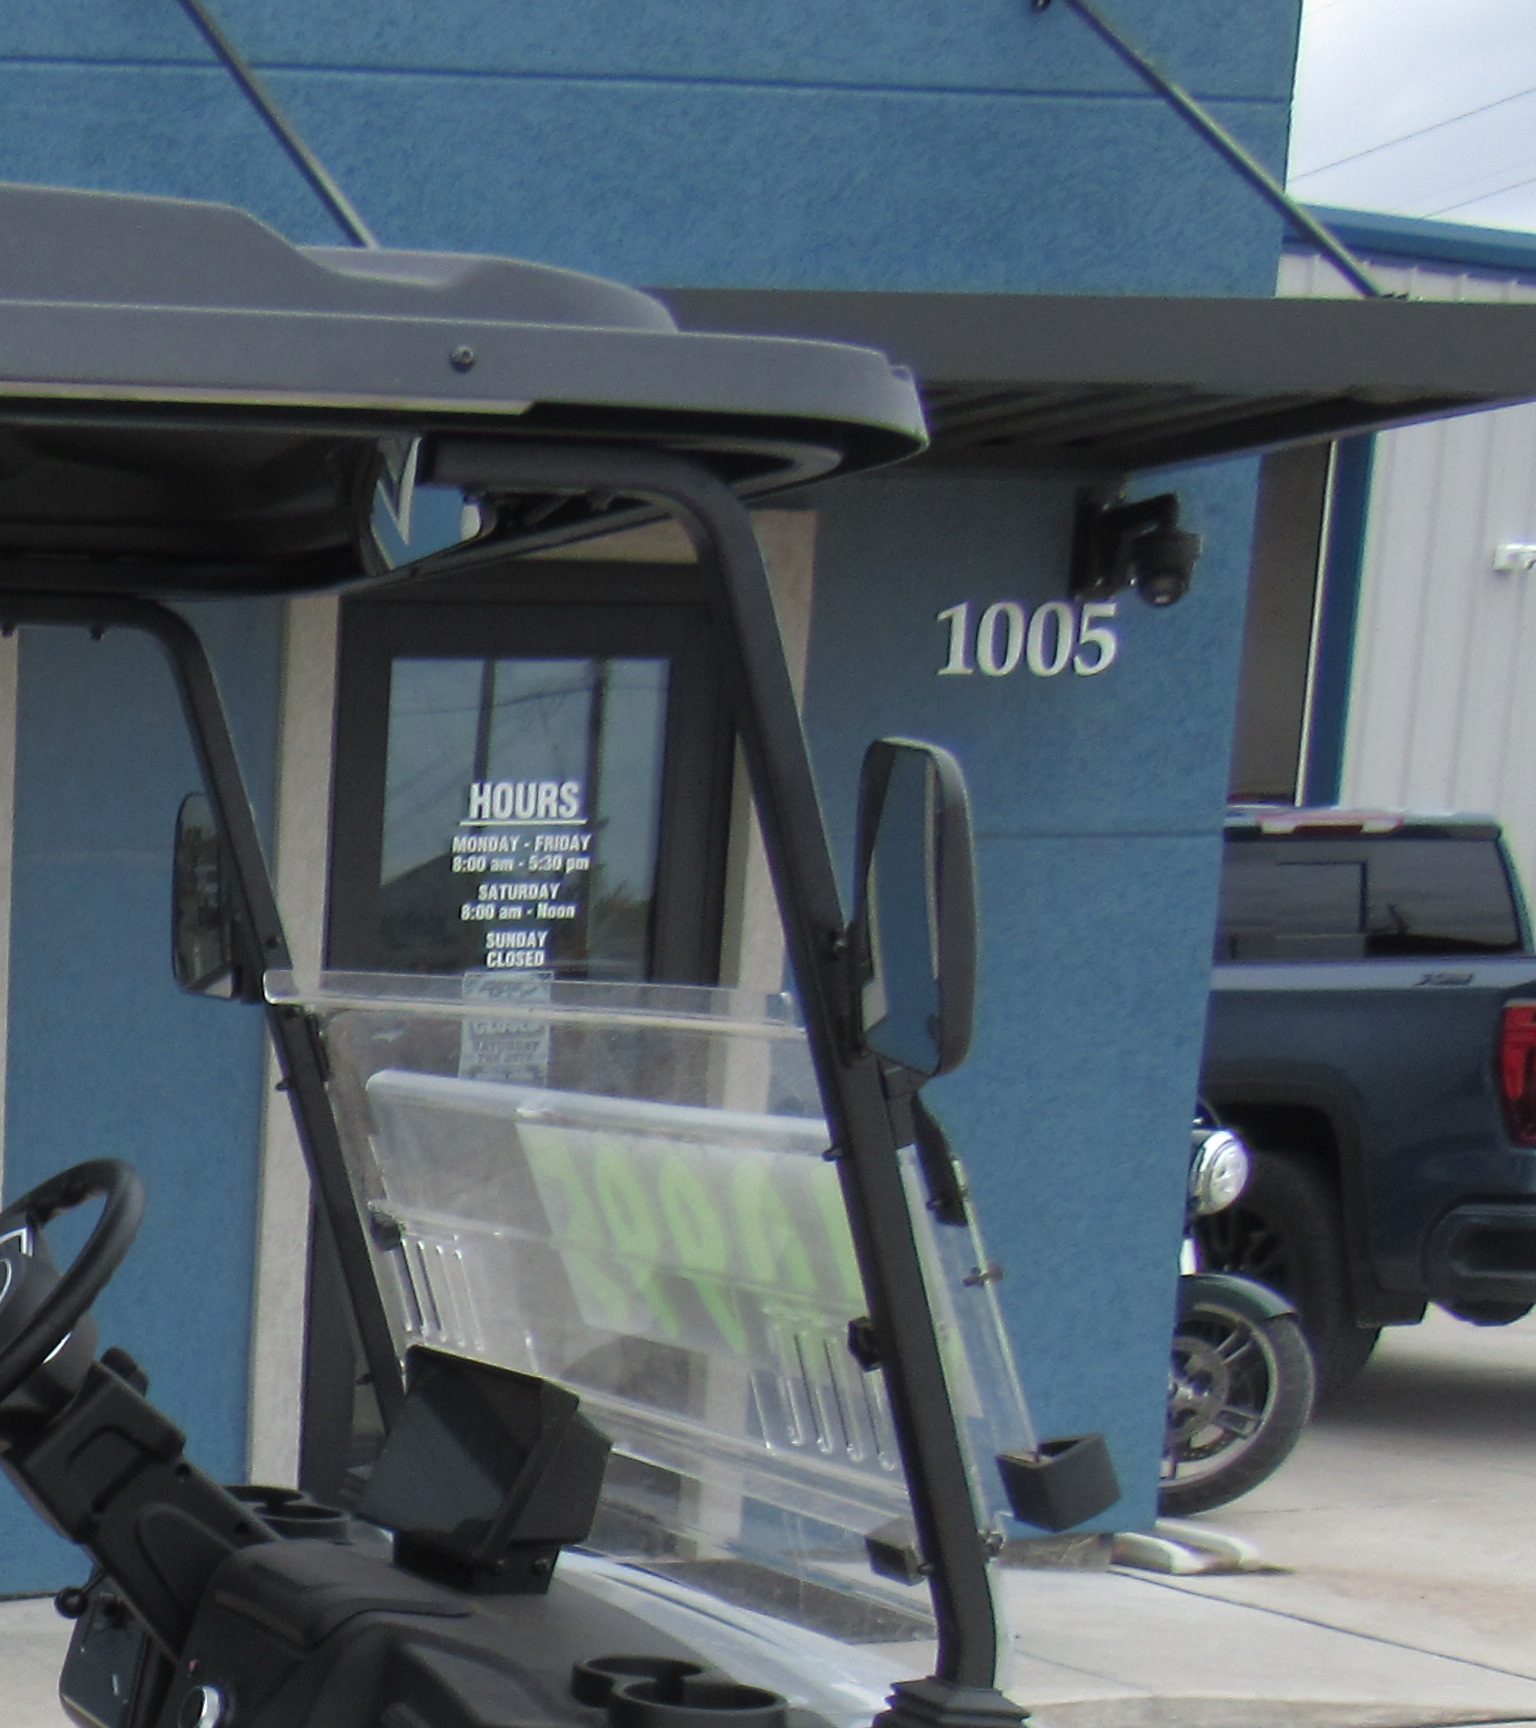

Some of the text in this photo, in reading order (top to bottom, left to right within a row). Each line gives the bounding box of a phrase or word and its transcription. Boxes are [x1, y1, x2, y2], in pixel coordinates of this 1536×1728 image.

[936, 601, 1117, 677] 1005
[468, 781, 580, 819] HOURS
[452, 835, 520, 853] MONDAY
[534, 834, 592, 852] FRIDAY
[452, 856, 486, 873] 8:00
[490, 859, 513, 872] am
[528, 855, 561, 871] 5:30
[566, 857, 590, 874] pm
[478, 883, 561, 901] SATURDAY
[461, 904, 495, 921] 8:00
[499, 906, 521, 919] am
[537, 902, 576, 919] Noon
[486, 931, 549, 949] SUNDAY
[486, 950, 545, 968] CLOSED
